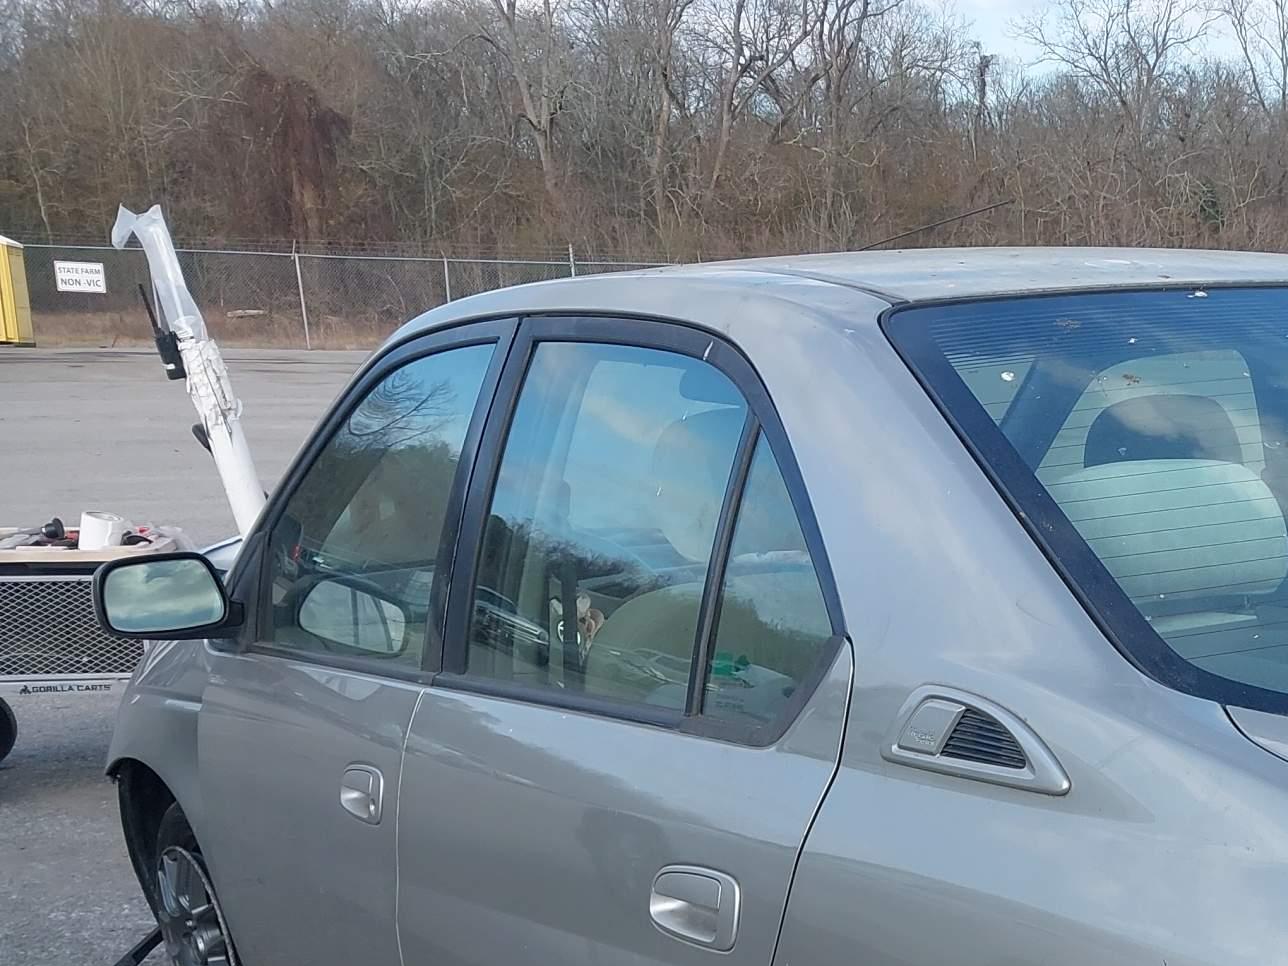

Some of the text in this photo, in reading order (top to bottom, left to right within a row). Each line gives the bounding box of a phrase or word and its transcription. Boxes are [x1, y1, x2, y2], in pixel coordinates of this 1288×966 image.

[60, 278, 82, 286] NON
[32, 684, 113, 694] GORILLA CARTS
